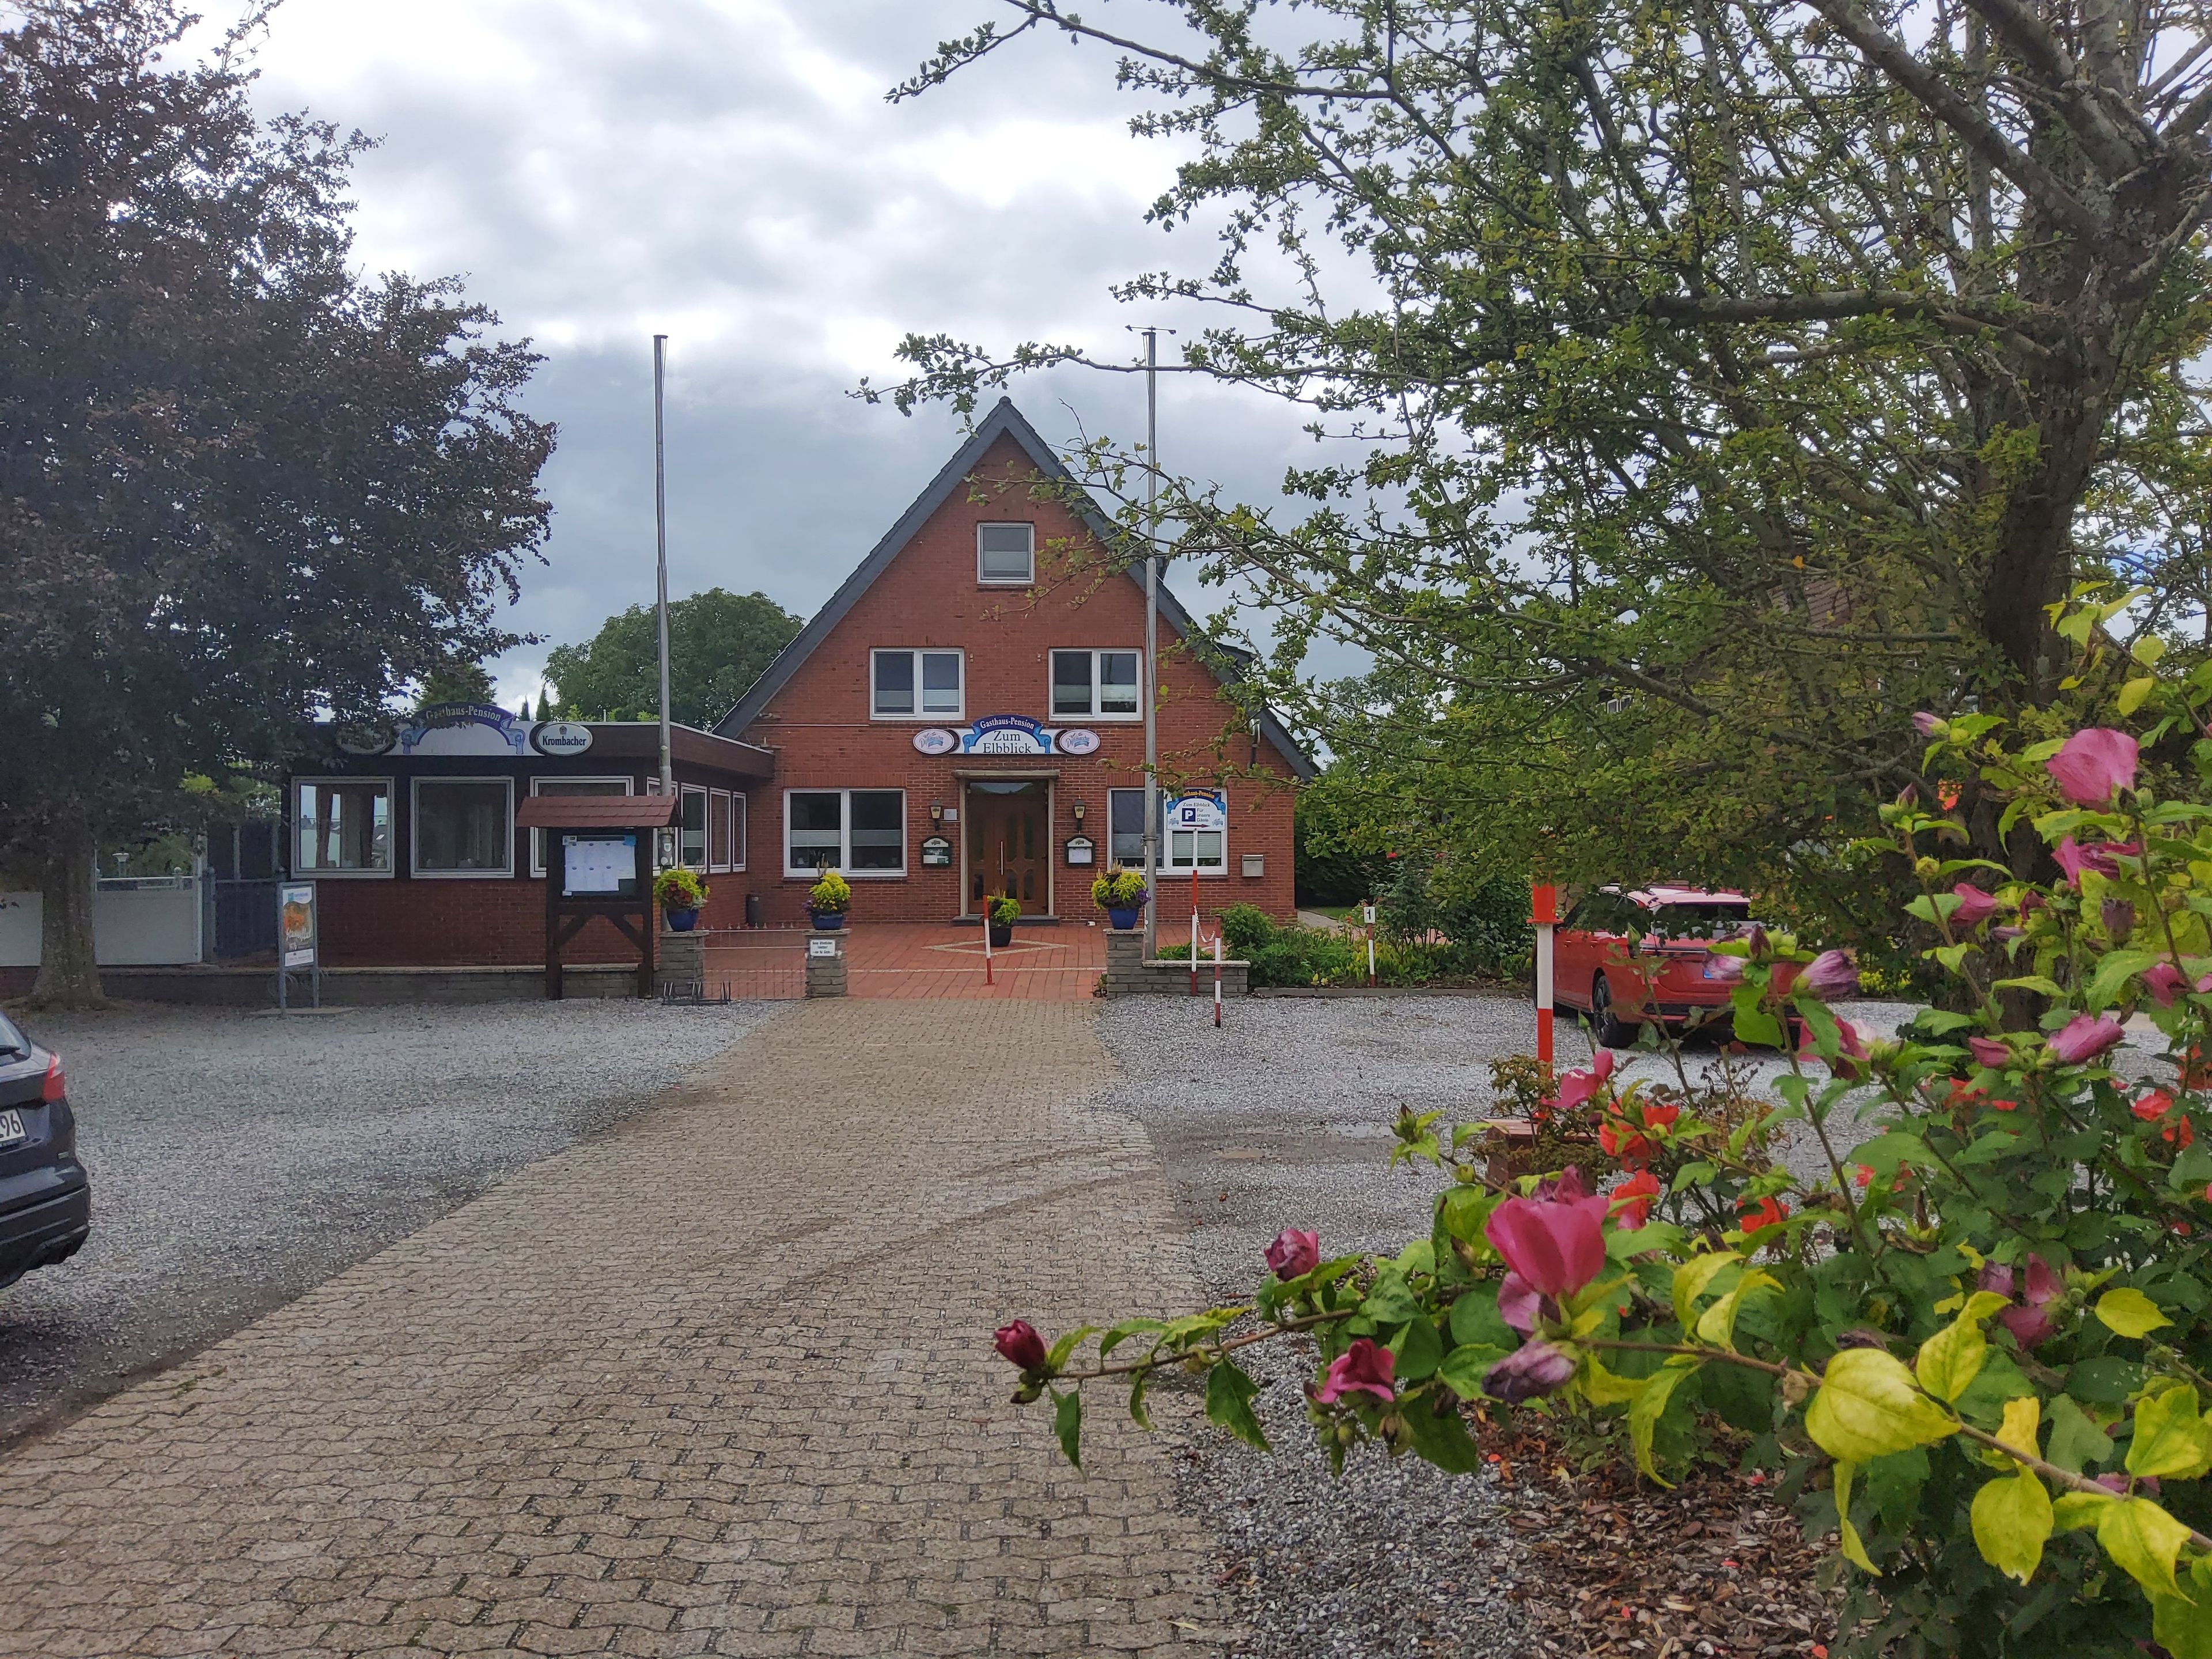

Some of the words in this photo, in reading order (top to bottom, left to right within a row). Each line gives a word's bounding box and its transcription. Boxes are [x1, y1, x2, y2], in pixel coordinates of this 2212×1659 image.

[980, 717, 1035, 729] Gasthaus-Pension
[542, 736, 587, 746] Krombacher
[994, 731, 1020, 741] Zum
[983, 743, 1032, 753] Elbblick
[1185, 810, 1194, 820] P
[1366, 909, 1371, 920] 1
[0, 1113, 21, 1138] 96
